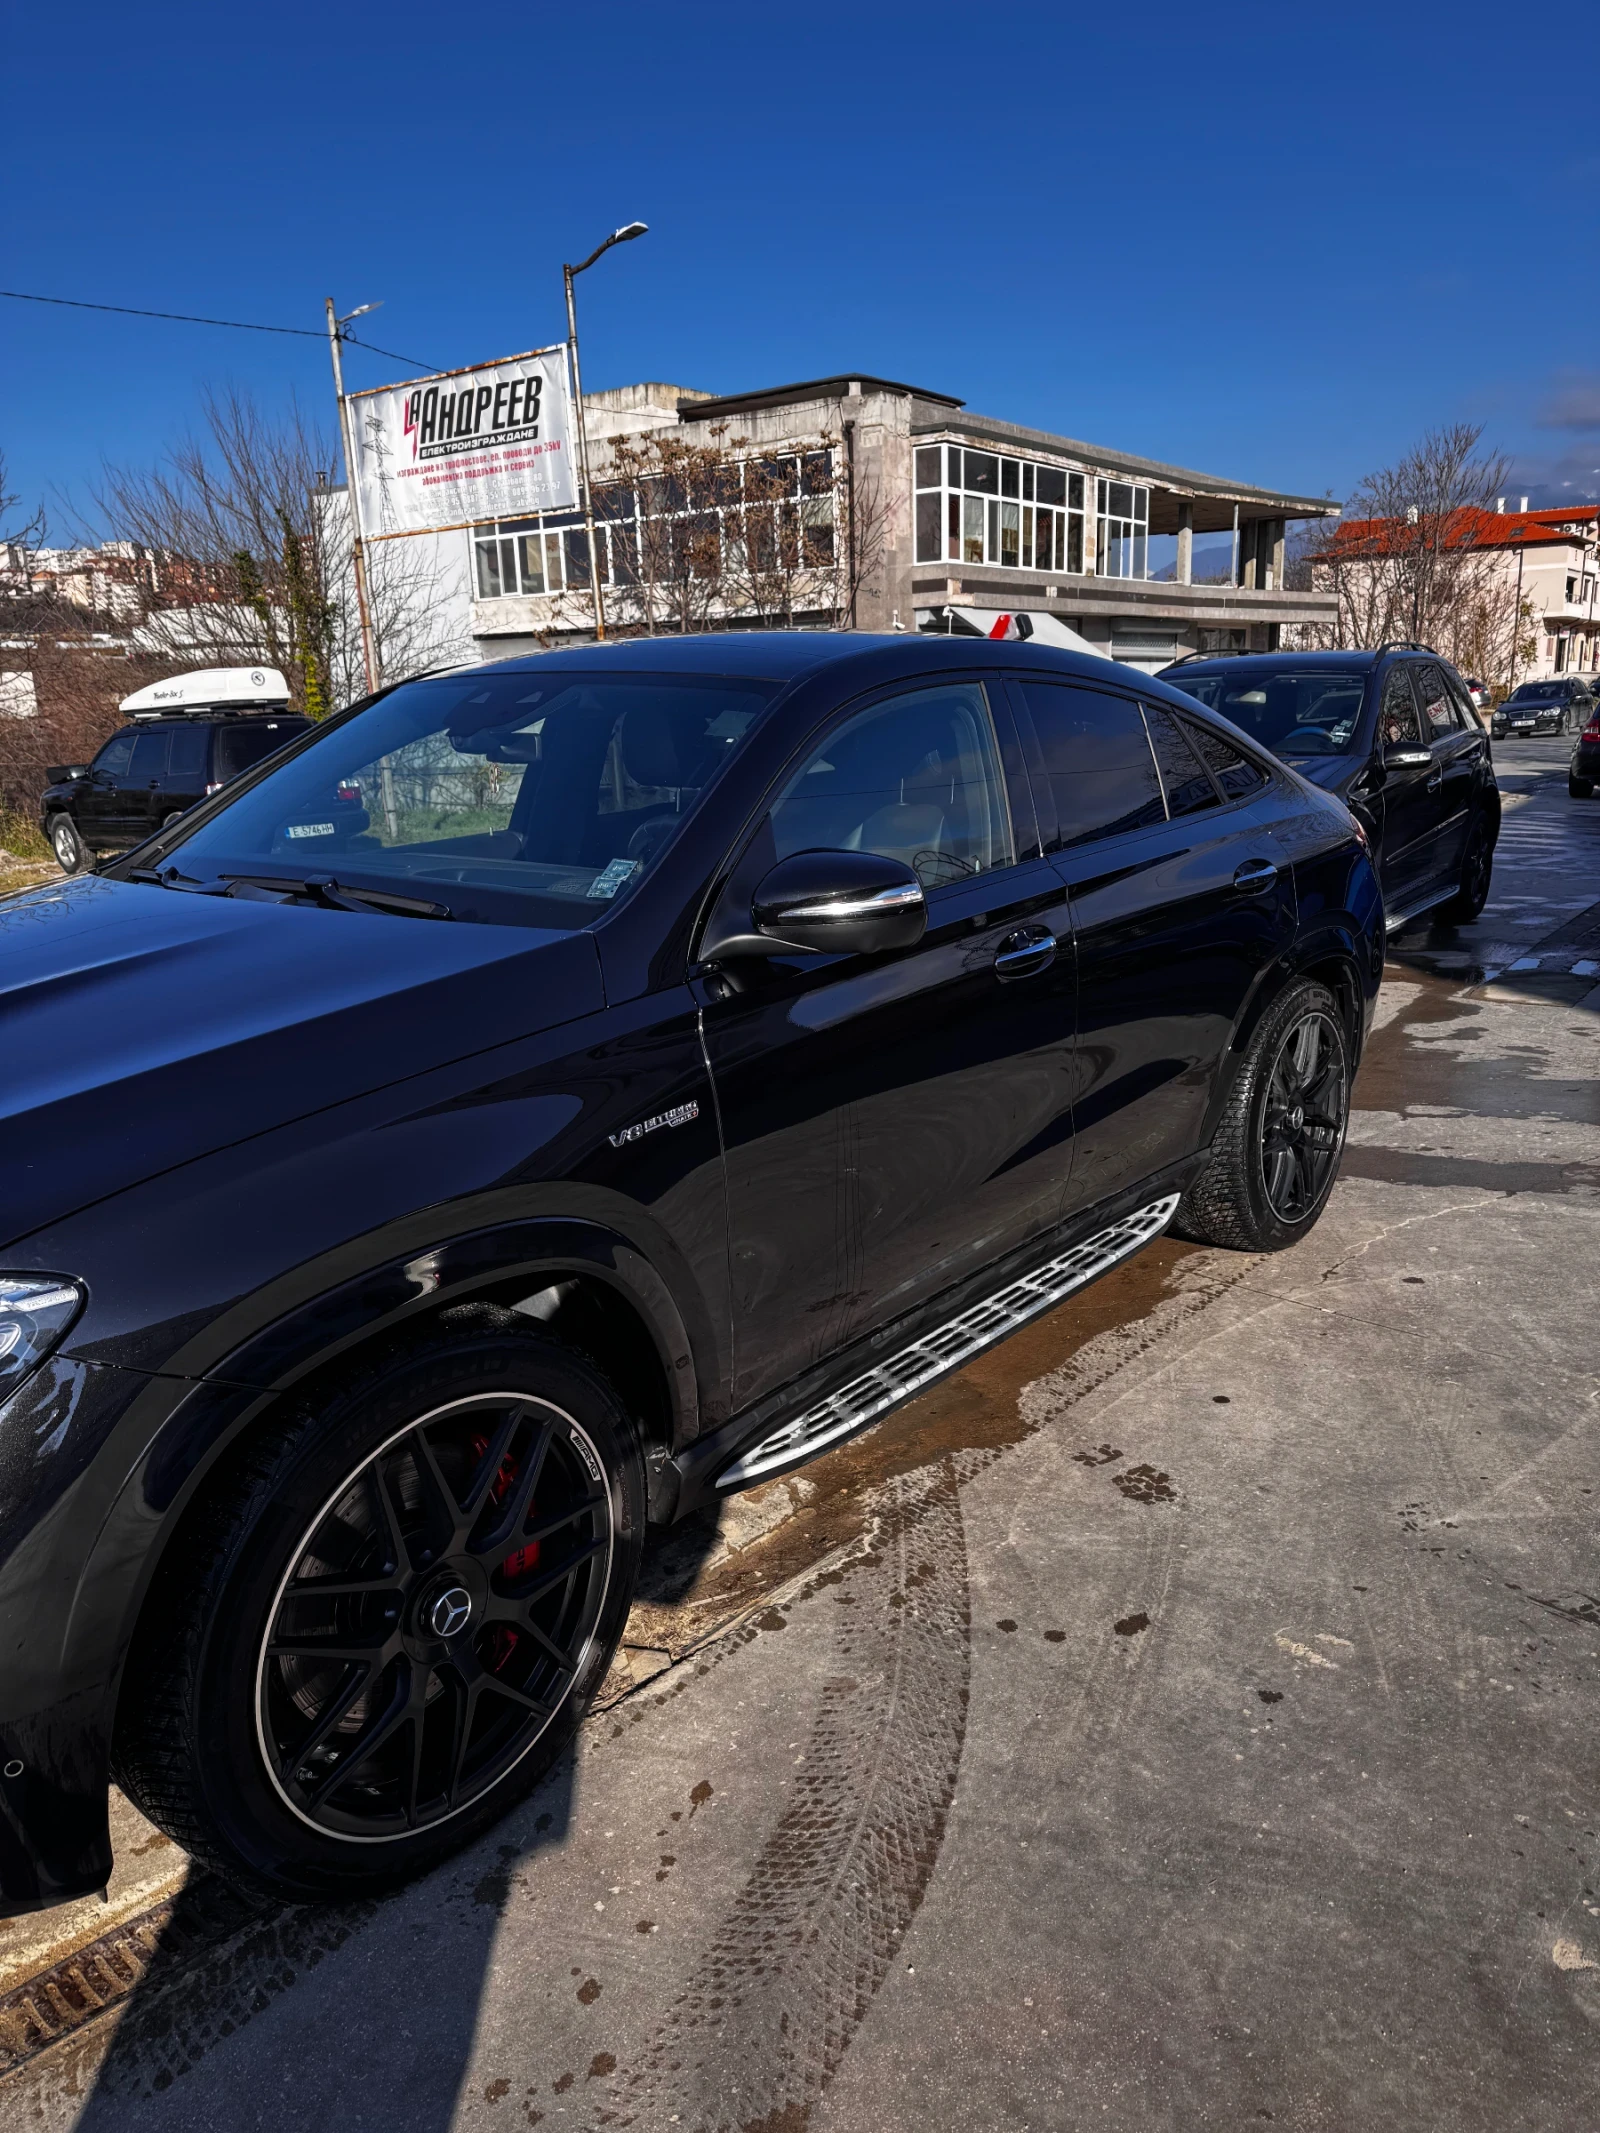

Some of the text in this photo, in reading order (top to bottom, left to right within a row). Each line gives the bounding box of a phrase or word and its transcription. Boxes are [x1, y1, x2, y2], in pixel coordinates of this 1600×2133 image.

[421, 428, 535, 458] ЕЛЕКТРОИЗГРАЖДАНЕ
[396, 464, 435, 478] изграждане
[533, 444, 543, 455] до
[579, 1445, 599, 1479] AMG
